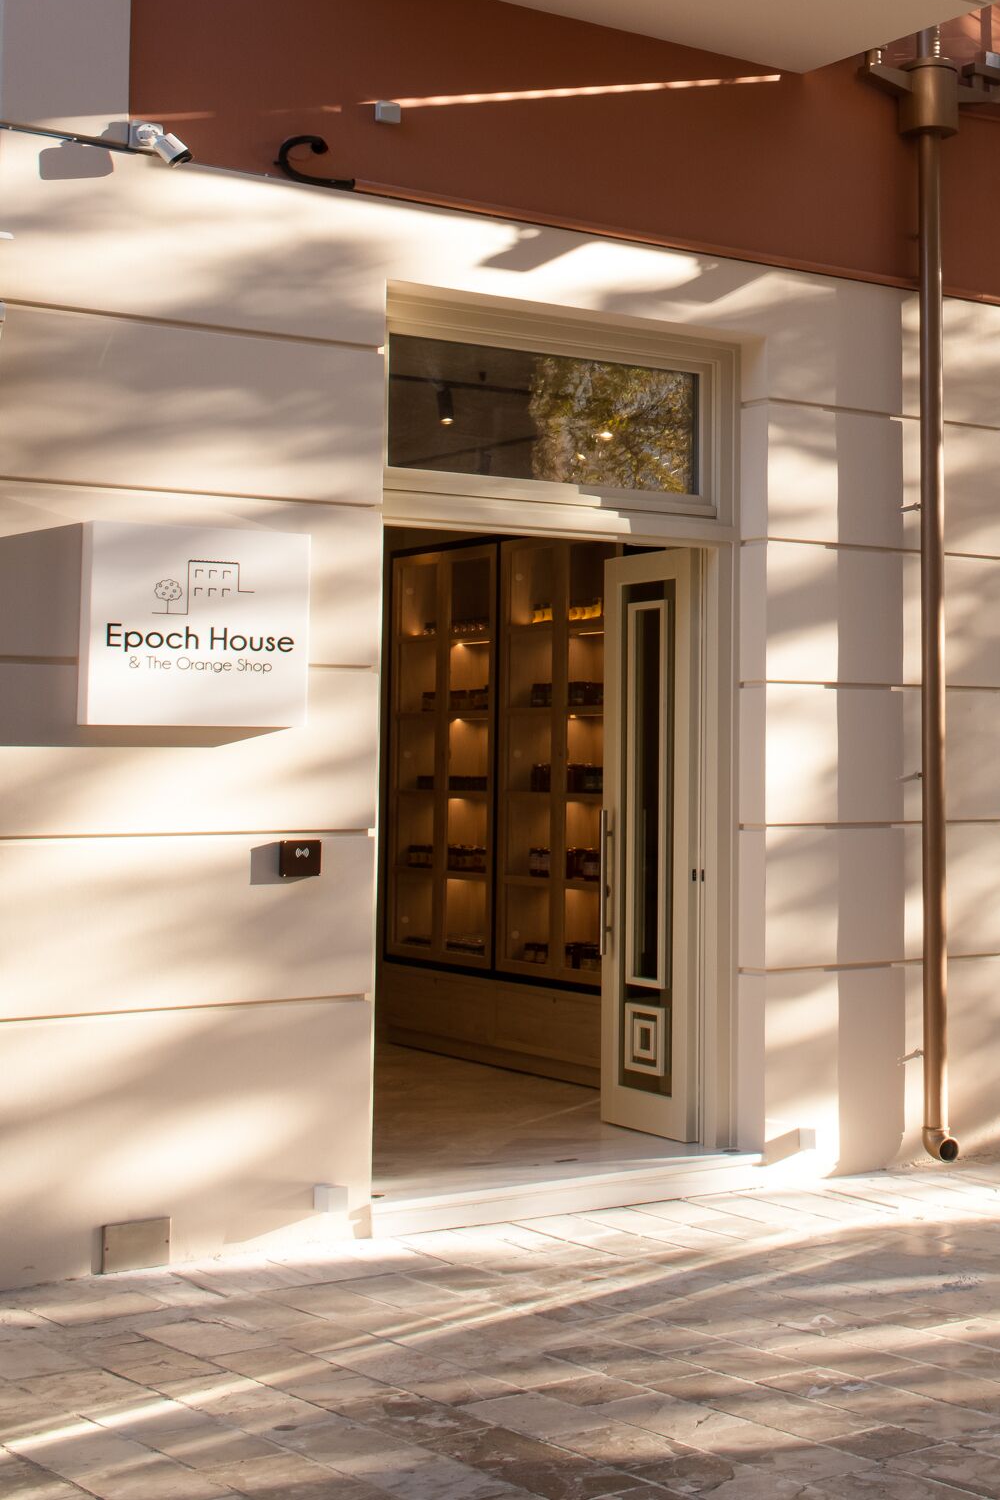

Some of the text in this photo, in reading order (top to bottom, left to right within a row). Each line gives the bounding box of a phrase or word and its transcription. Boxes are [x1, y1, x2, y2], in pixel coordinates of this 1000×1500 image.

[106, 622, 295, 653] Epoch House
[128, 655, 273, 674] & The Orange Shop
